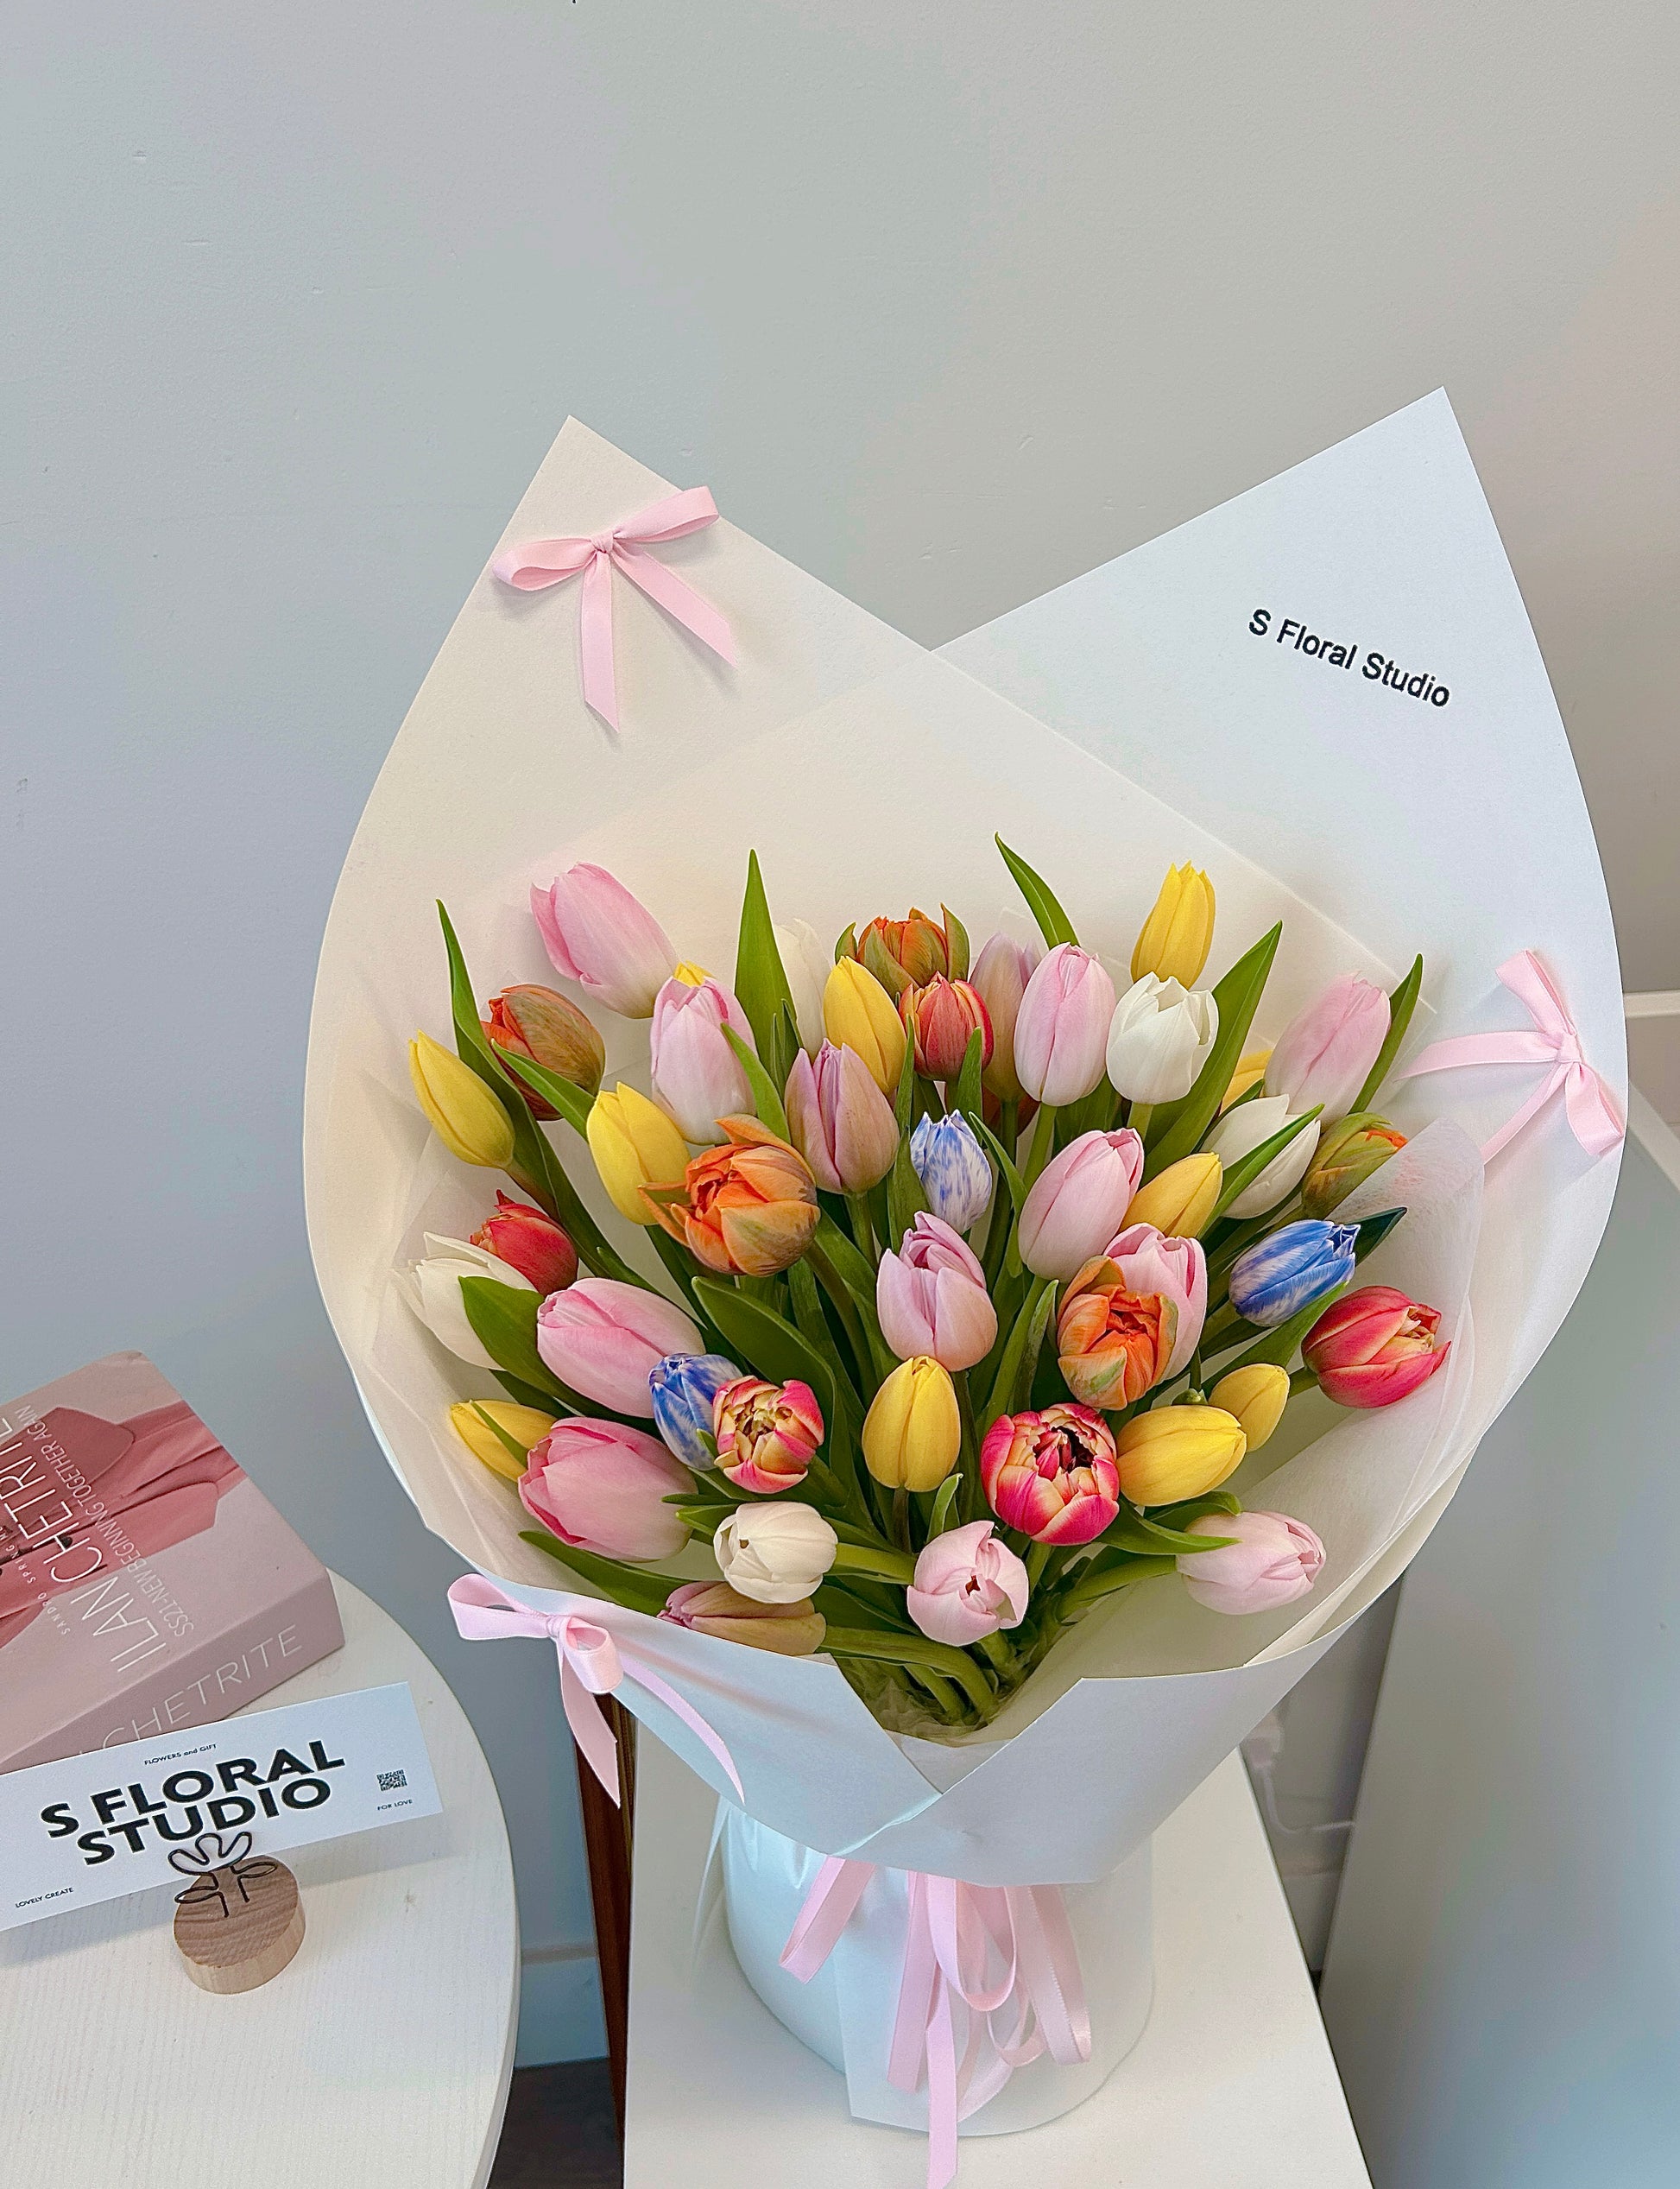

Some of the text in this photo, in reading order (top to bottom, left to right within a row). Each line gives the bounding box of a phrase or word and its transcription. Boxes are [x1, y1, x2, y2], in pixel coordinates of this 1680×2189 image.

[1249, 609, 1449, 707] S Floral Studio
[14, 1404, 194, 1637] SS21-NEW BEGINNING TOGETHER AGAIN
[5, 1544, 71, 1635] SANDRO SPRING
[70, 1576, 167, 1673] ILAN
[41, 1740, 346, 1838] S FLORAL
[144, 1743, 217, 1765] FLOWERS and GIFT
[77, 1777, 332, 1866] STUDIO
[394, 1799, 414, 1808] LOVE
[15, 1887, 74, 1908] LOVELY CREATE
